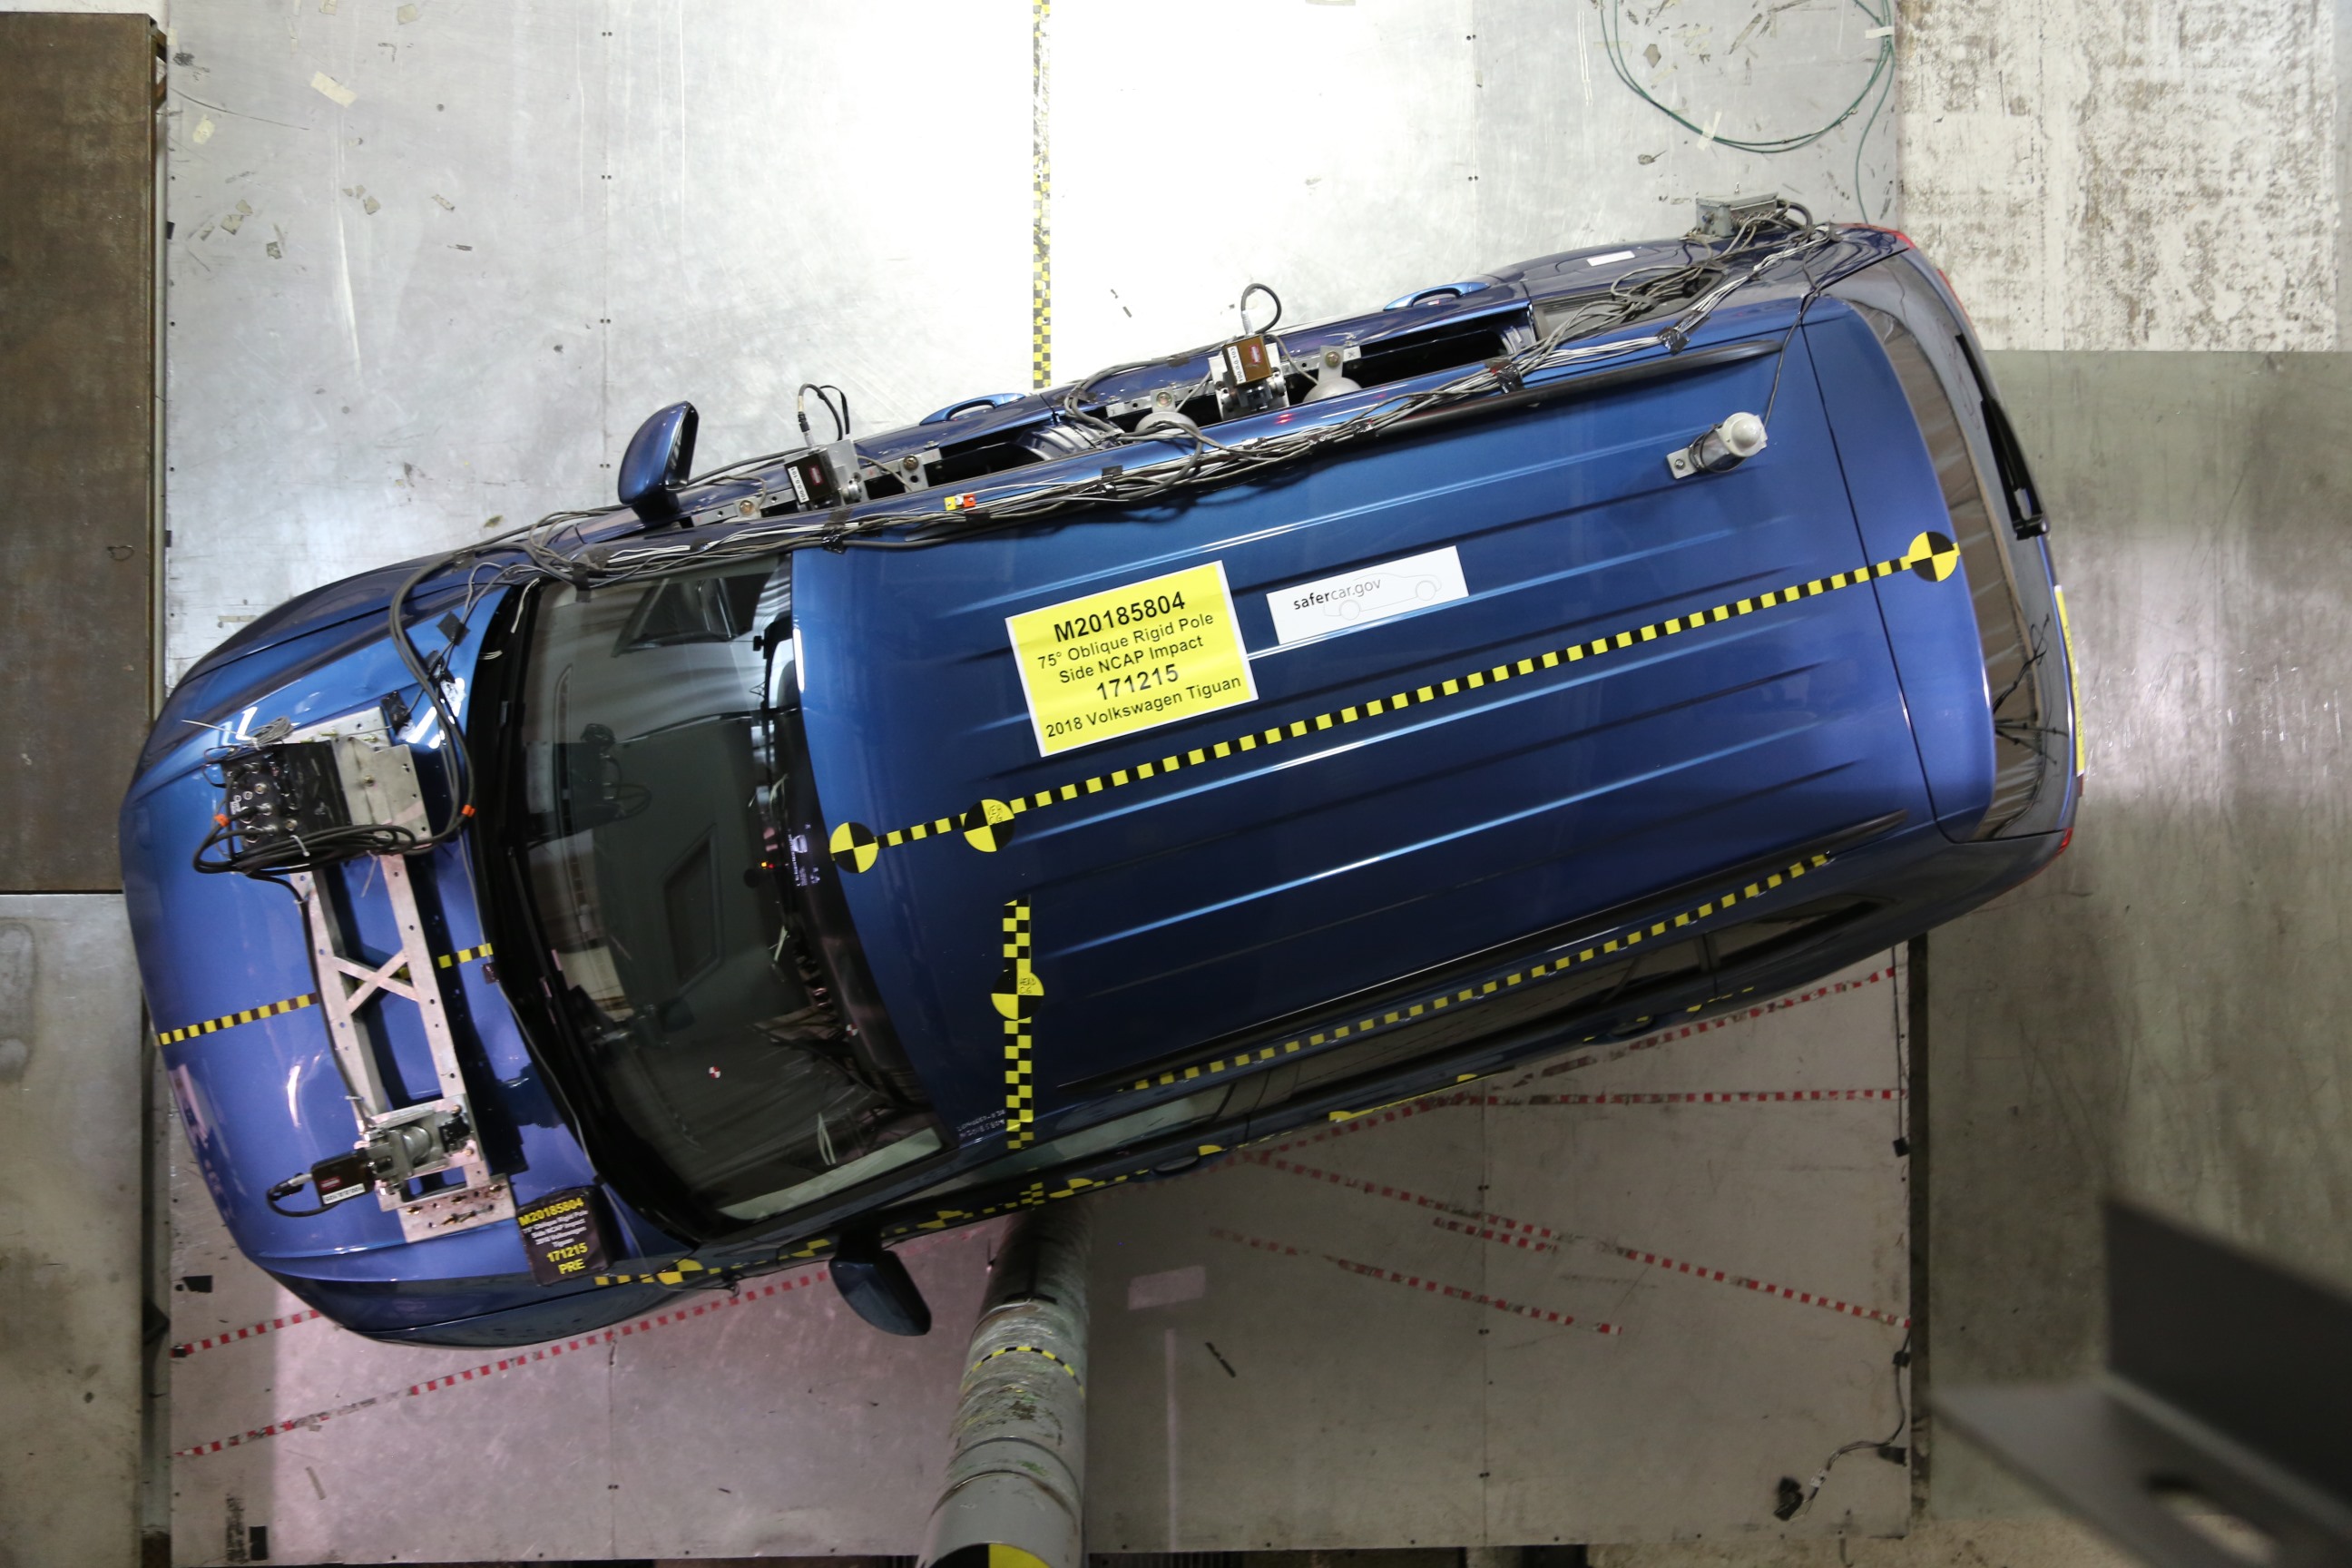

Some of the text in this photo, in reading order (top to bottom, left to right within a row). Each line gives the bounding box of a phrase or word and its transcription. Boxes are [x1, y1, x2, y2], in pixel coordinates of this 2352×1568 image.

[1293, 579, 1381, 610] safercar.gov
[1054, 591, 1185, 642] M20185804
[1037, 613, 1214, 669] 75° Oblique Rigid Pole
[1059, 635, 1203, 683] Side NCAP Impact
[1096, 663, 1179, 701] 171215
[1045, 677, 1241, 738] 2018 Volkswagen Tiguan
[518, 1197, 584, 1226] M20185804
[546, 1241, 588, 1262] 171215
[558, 1258, 586, 1275] PRE
